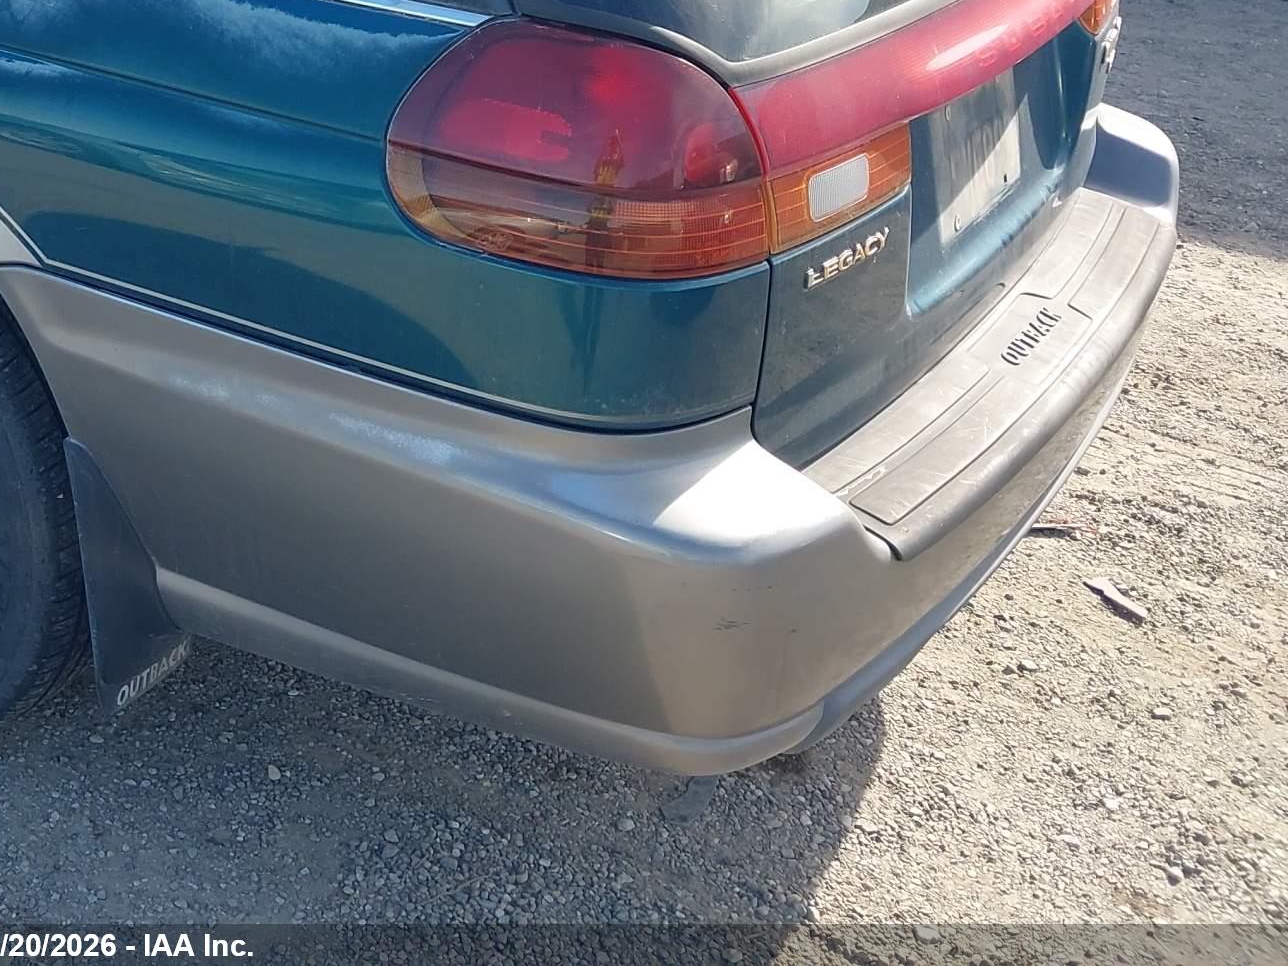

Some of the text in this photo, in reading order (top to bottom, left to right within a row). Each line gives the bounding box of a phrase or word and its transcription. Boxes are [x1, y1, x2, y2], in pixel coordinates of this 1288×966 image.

[803, 226, 890, 291] LEGACY
[1000, 306, 1063, 367] OUTBACK
[116, 638, 190, 707] OUTBACK
